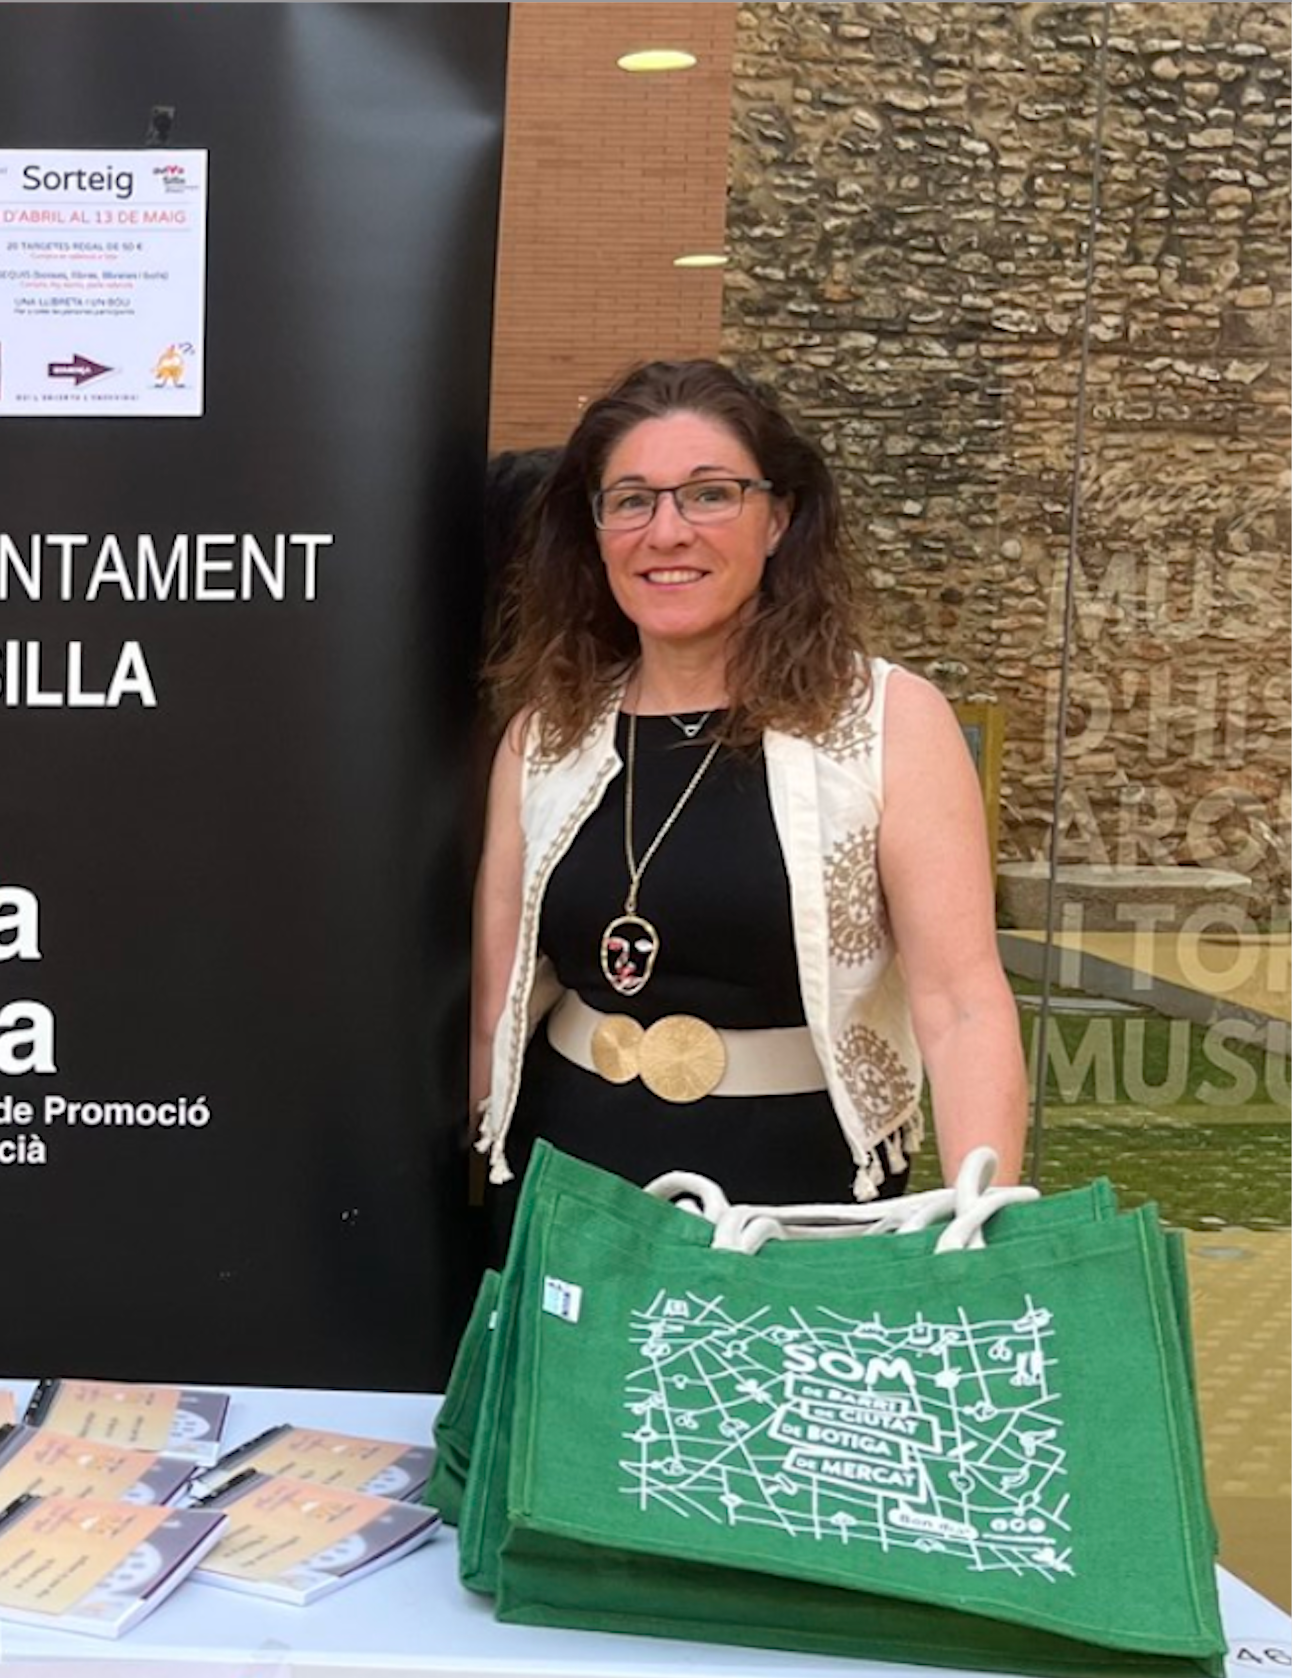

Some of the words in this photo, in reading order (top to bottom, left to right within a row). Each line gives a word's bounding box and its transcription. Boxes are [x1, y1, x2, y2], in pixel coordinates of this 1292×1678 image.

[22, 165, 134, 199] Sorteig
[3, 209, 65, 224] D'ABRIL
[69, 210, 90, 223] AL
[95, 210, 113, 224] 13
[117, 210, 138, 224] DE
[142, 210, 187, 224] MAIG
[1059, 902, 1084, 988] I
[44, 1095, 211, 1127] Promoció
[782, 1343, 917, 1386] SOM
[827, 1387, 898, 1414] BARRI
[839, 1409, 919, 1436] CIUTAT
[781, 1422, 803, 1439] DE
[806, 1424, 893, 1457] BOTIGA
[795, 1457, 819, 1473] DE
[820, 1457, 917, 1489] MERCAT
[898, 1512, 936, 1529] Bon
